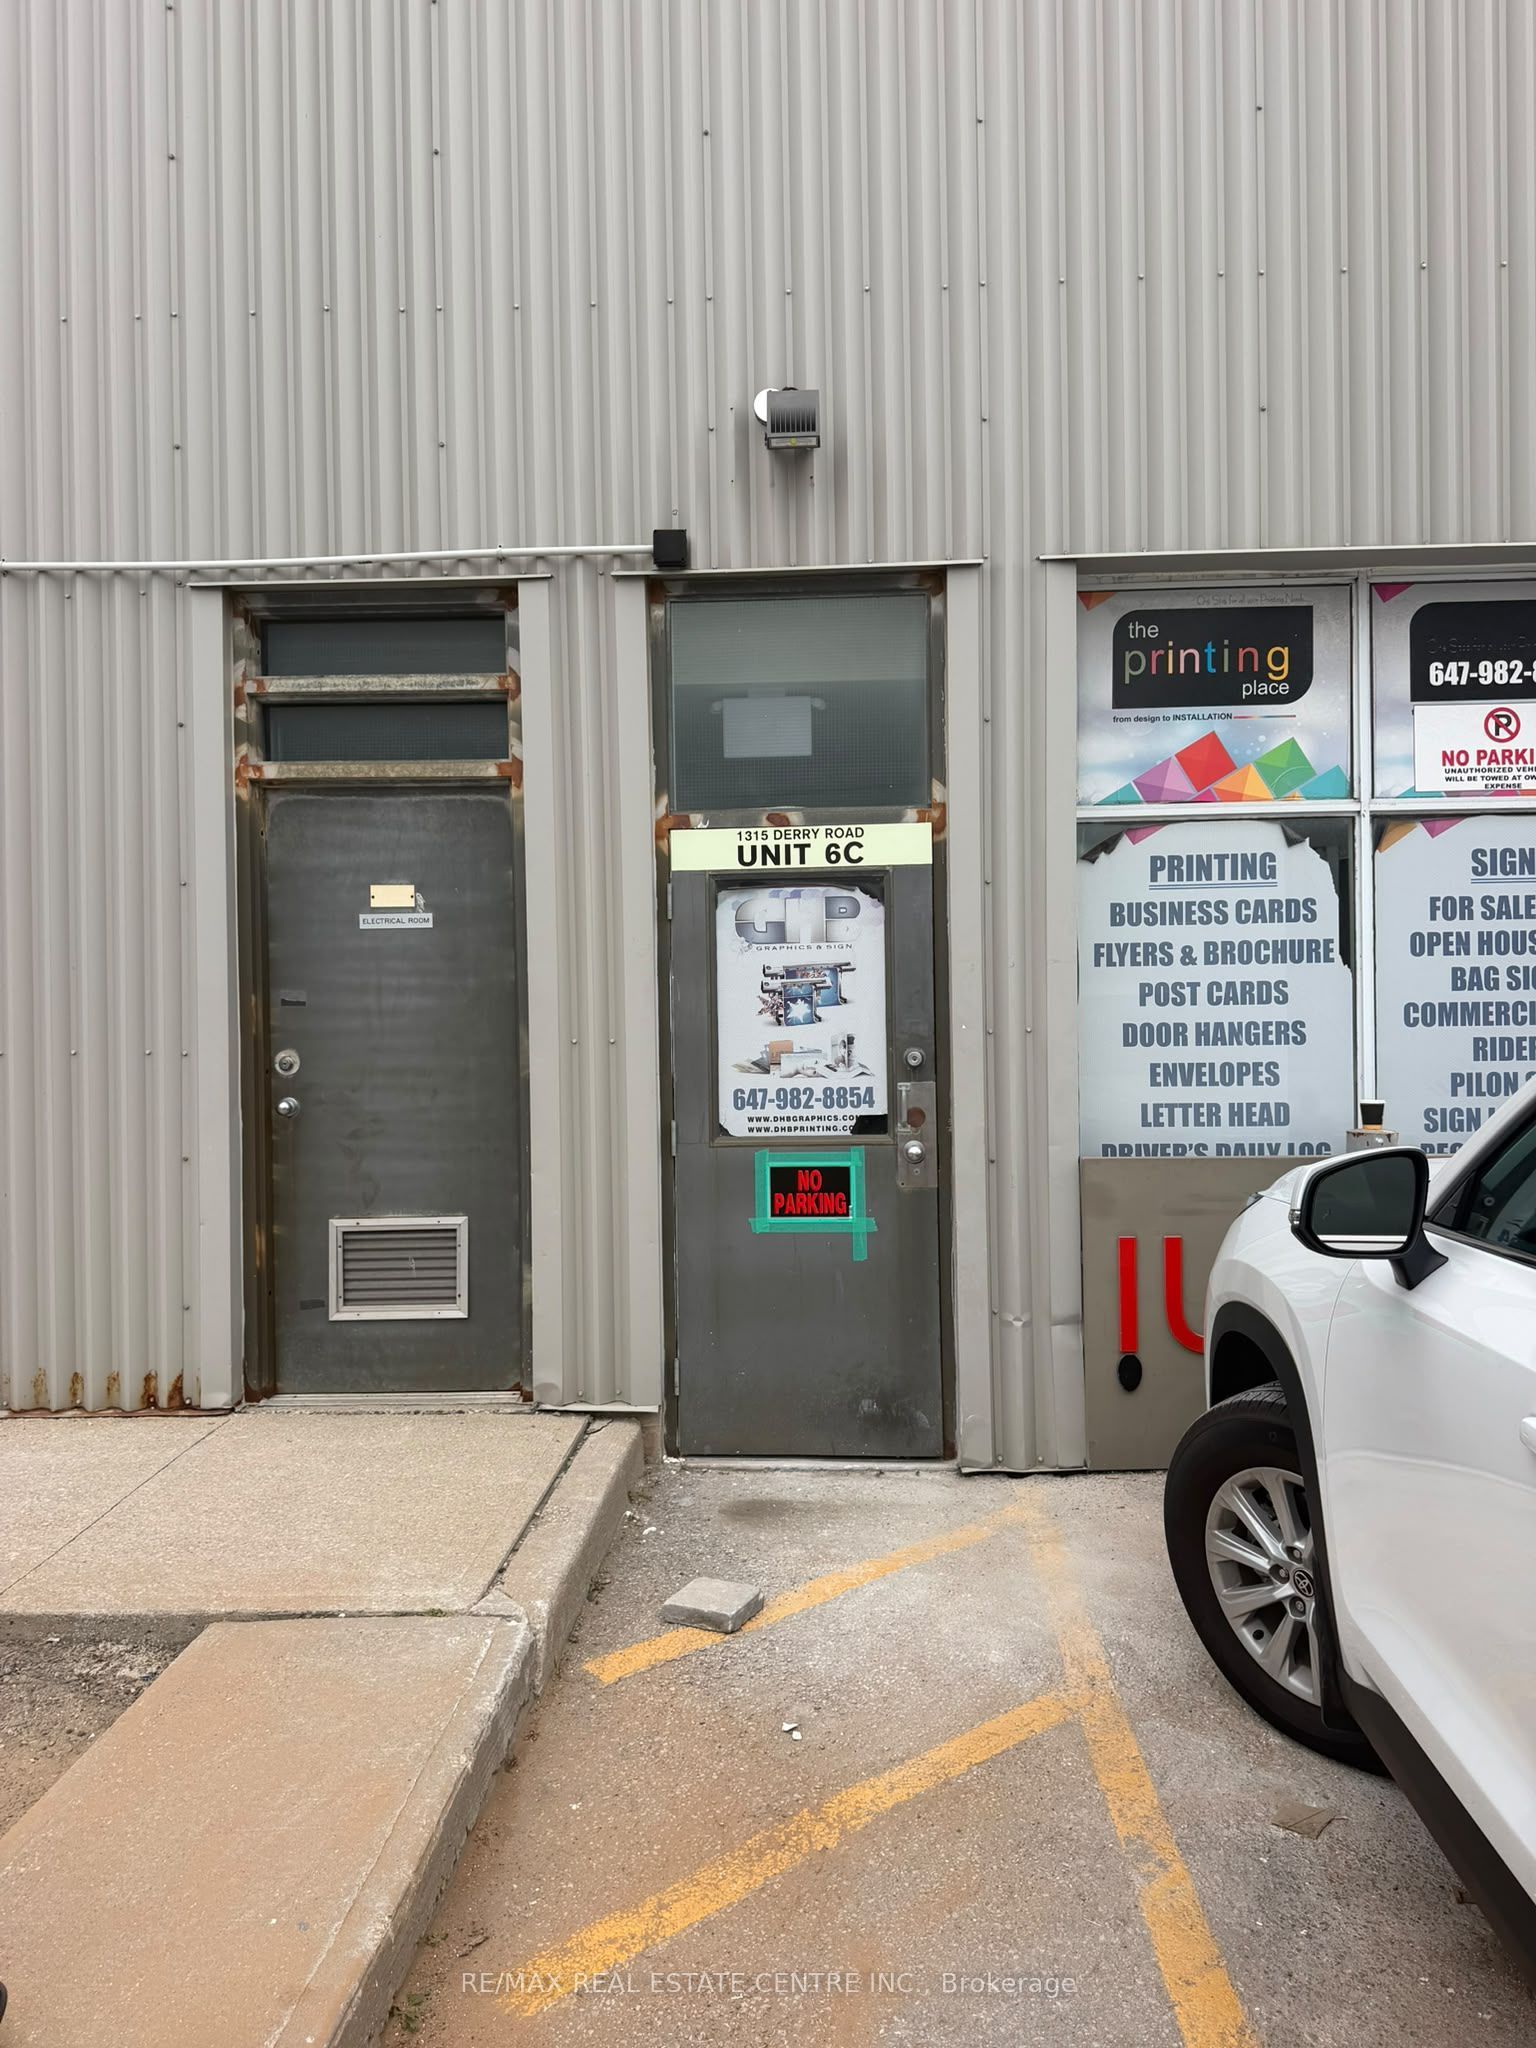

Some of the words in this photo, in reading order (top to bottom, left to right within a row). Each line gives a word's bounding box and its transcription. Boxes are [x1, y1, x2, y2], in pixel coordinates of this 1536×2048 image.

[1128, 621, 1159, 639] the
[1124, 640, 1290, 684] printing
[1429, 659, 1536, 686] 647-982-
[1242, 680, 1290, 699] place
[1113, 714, 1131, 724] from
[1133, 713, 1161, 724] design
[1162, 713, 1171, 722] to
[1172, 712, 1233, 722] INSTALLATION
[1442, 749, 1469, 767] NO
[1444, 767, 1513, 775] UNAUTHORIZED
[736, 829, 770, 842] 1315
[773, 828, 820, 841] DERRY
[824, 827, 865, 840] ROAD
[737, 842, 811, 867] UNIT
[825, 840, 865, 865] 6C
[1149, 852, 1277, 883] PRINTING
[362, 917, 406, 925] ELECTRICAL
[1110, 899, 1229, 927] BUSINESS
[1235, 897, 1317, 924] CARDS
[1429, 896, 1474, 921] FOR
[1094, 941, 1174, 968] FLYERS
[1180, 944, 1198, 966] &
[1203, 938, 1335, 966] BROCHURE
[1410, 931, 1470, 957] OPEN
[1451, 965, 1500, 991] BAG
[1139, 982, 1200, 1007] POST
[1207, 980, 1289, 1006] CARDS
[1122, 1022, 1188, 1048] DOOR
[1195, 1020, 1307, 1047] HANGERS
[1149, 1062, 1280, 1087] ENVELOPES
[1451, 1071, 1519, 1097] PILON
[733, 1086, 875, 1111] 647-982-8854
[1141, 1103, 1221, 1128] LETTER
[1229, 1102, 1290, 1128] HEAD
[1424, 1107, 1481, 1133] SIGN
[797, 1169, 822, 1191] NO
[774, 1192, 848, 1215] PARKING
